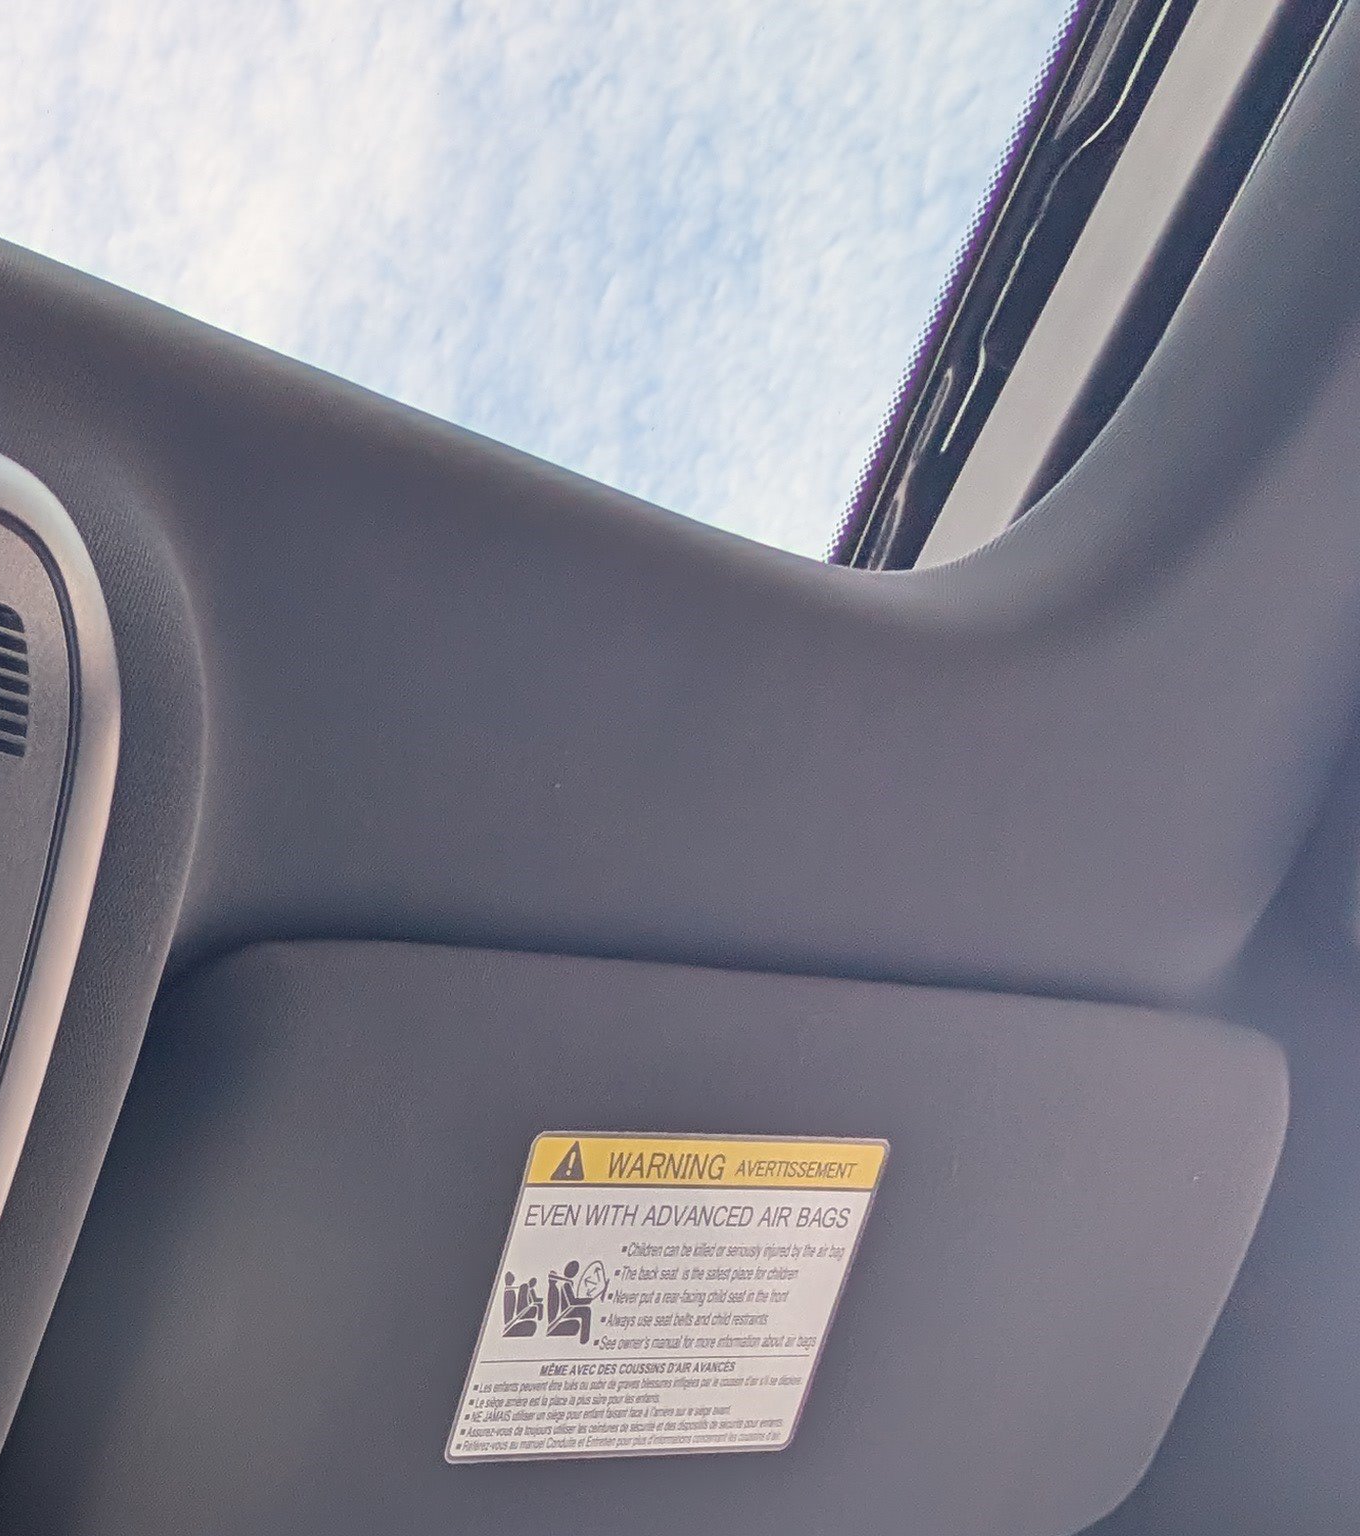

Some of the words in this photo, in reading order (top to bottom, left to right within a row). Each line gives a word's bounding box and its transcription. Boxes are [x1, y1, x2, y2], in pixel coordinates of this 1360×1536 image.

[608, 1151, 726, 1180] WARNING
[734, 1159, 858, 1179] AVERTISSEMENT
[524, 1204, 582, 1227] EVEN
[585, 1204, 639, 1227] WITH
[641, 1204, 754, 1227] ADVANCED
[757, 1206, 792, 1228] AIR
[796, 1206, 851, 1229] BAGS
[627, 1242, 663, 1257] Children
[663, 1245, 680, 1257] can
[681, 1243, 692, 1257] be
[716, 1246, 726, 1257] or
[791, 1244, 802, 1260] by
[802, 1244, 816, 1258] the
[816, 1244, 829, 1258] air
[828, 1244, 846, 1261] bag
[621, 1266, 637, 1280] The
[638, 1266, 659, 1280] back
[660, 1268, 679, 1280] seat
[681, 1269, 691, 1280] is
[691, 1267, 705, 1280] the
[730, 1267, 754, 1283] place
[754, 1266, 767, 1280] for
[767, 1266, 799, 1280] children
[613, 1290, 639, 1304] Never
[638, 1290, 654, 1307] put
[654, 1293, 661, 1304] a
[707, 1289, 728, 1303] child
[727, 1290, 747, 1303] seat
[745, 1290, 755, 1303] in
[755, 1289, 770, 1303] the
[769, 1289, 789, 1303] front
[606, 1313, 637, 1331] Always
[637, 1316, 653, 1327] use
[653, 1313, 673, 1327] seat
[673, 1313, 694, 1327] belts
[694, 1313, 712, 1326] and
[711, 1313, 732, 1326] child
[599, 1335, 617, 1350] See
[650, 1335, 683, 1349] manual
[683, 1335, 695, 1349] for
[695, 1337, 717, 1349] more
[761, 1333, 785, 1348] about
[568, 1363, 597, 1375] AVEC
[597, 1363, 617, 1375] DES
[619, 1362, 666, 1375] COUSSINS
[666, 1362, 692, 1374] D'AIR
